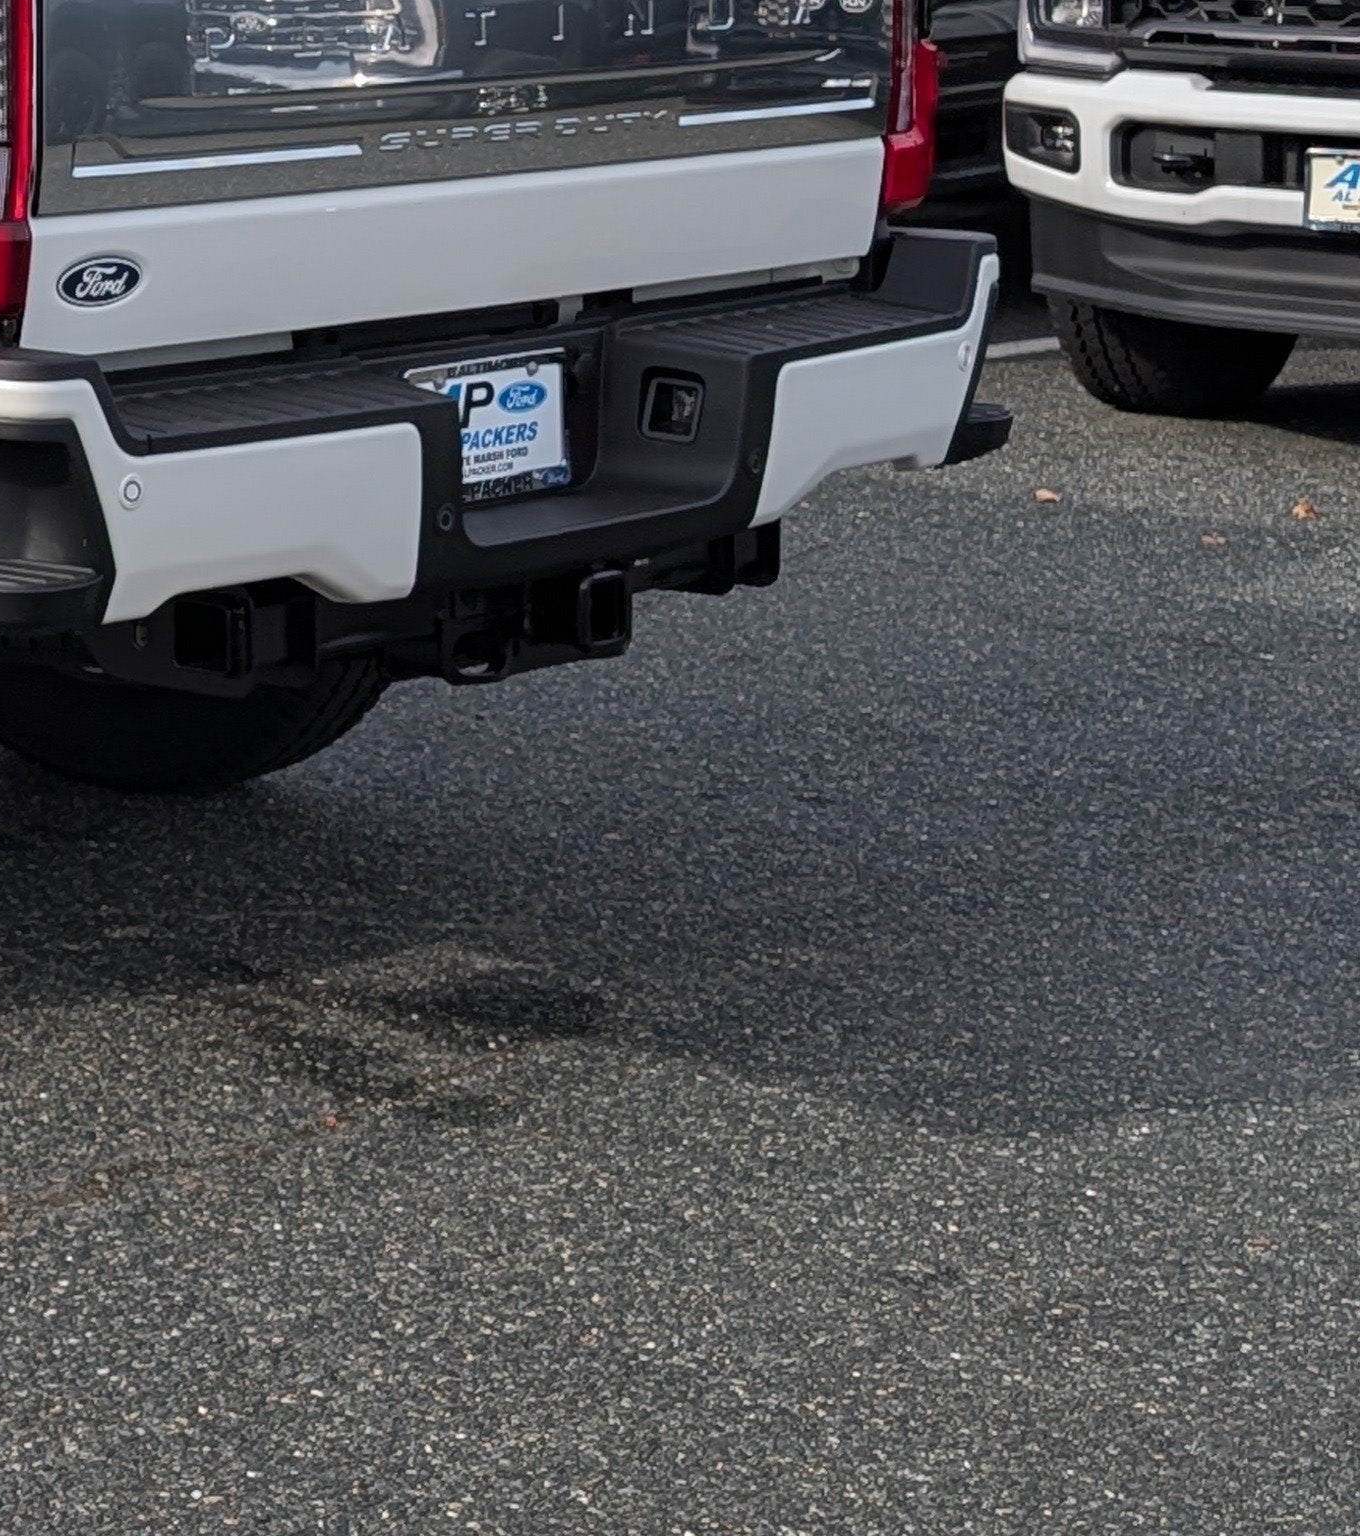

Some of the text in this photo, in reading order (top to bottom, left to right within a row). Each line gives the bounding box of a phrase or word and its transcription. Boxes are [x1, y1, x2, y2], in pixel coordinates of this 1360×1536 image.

[379, 120, 545, 151] SUPER
[75, 265, 129, 298] Ford
[461, 421, 539, 451] PACKERS
[473, 450, 504, 464] MARSH
[506, 446, 529, 460] FORD
